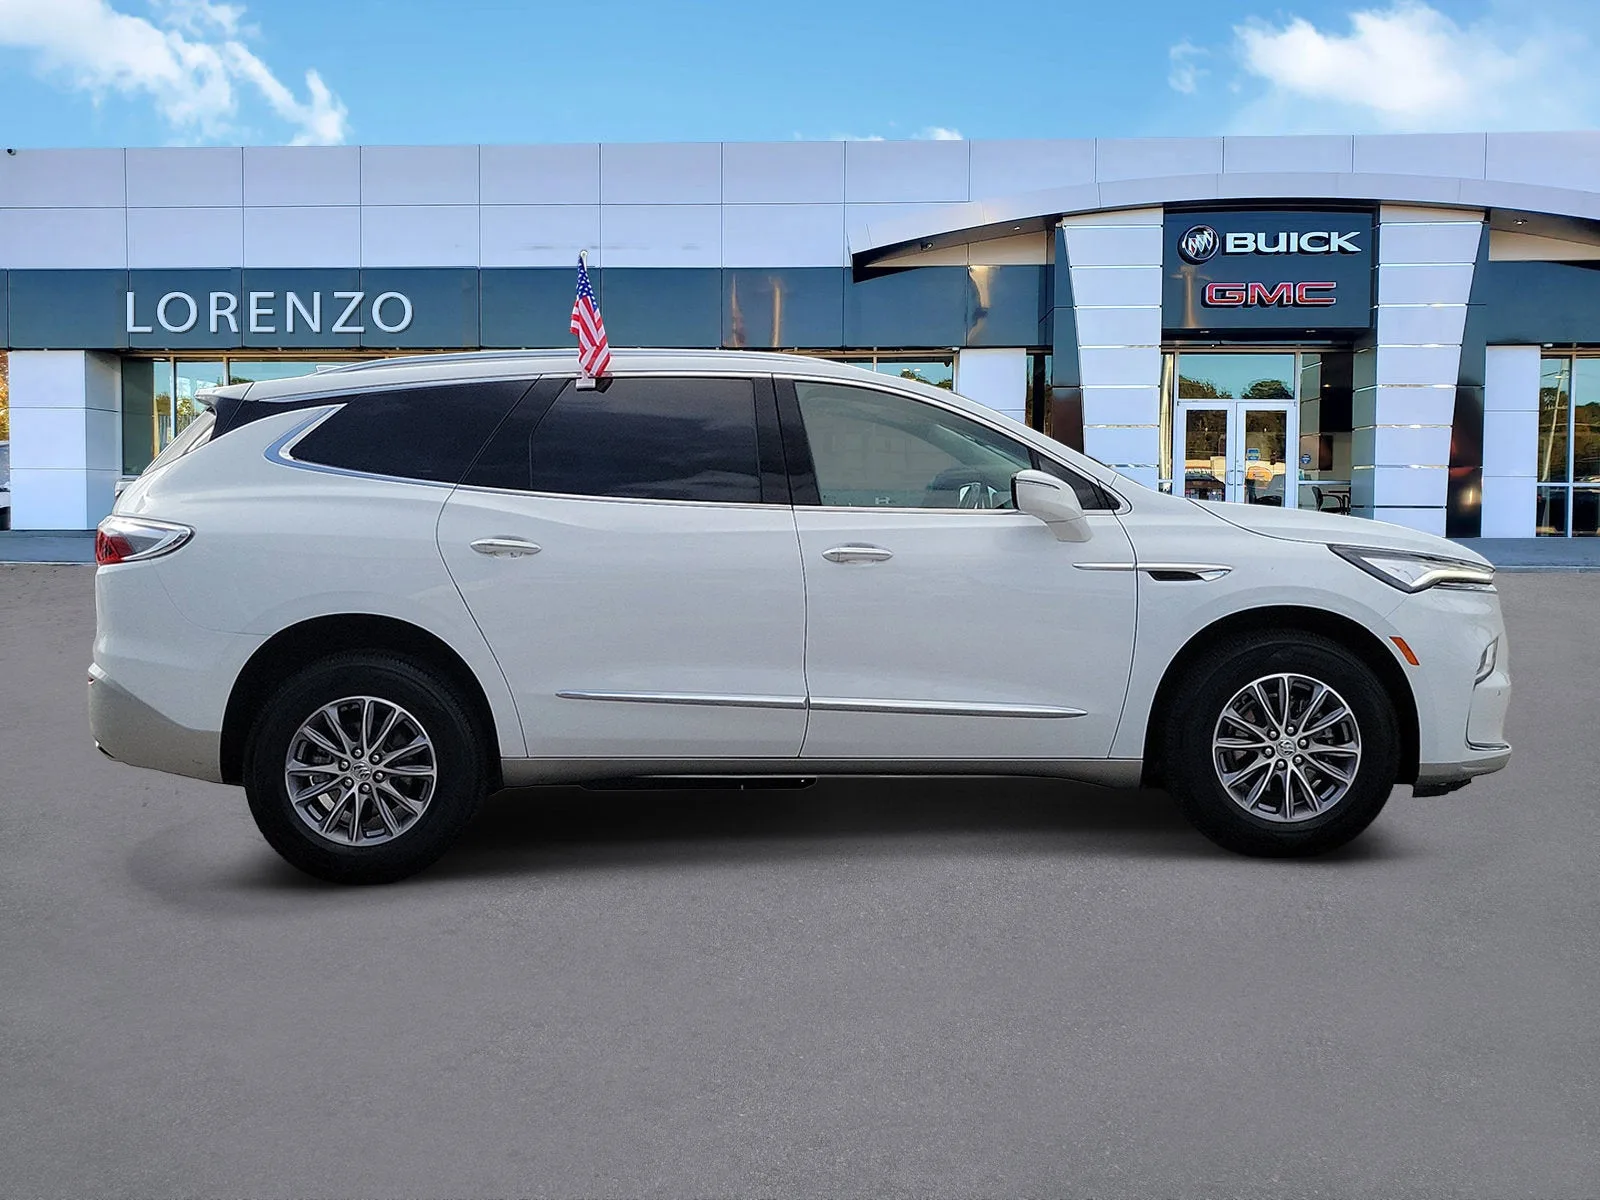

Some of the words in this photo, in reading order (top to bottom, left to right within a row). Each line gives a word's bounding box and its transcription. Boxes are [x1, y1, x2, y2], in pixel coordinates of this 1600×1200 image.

[1225, 231, 1361, 253] BUICK
[1204, 282, 1337, 306] GMC
[126, 291, 413, 333] LORENZO
